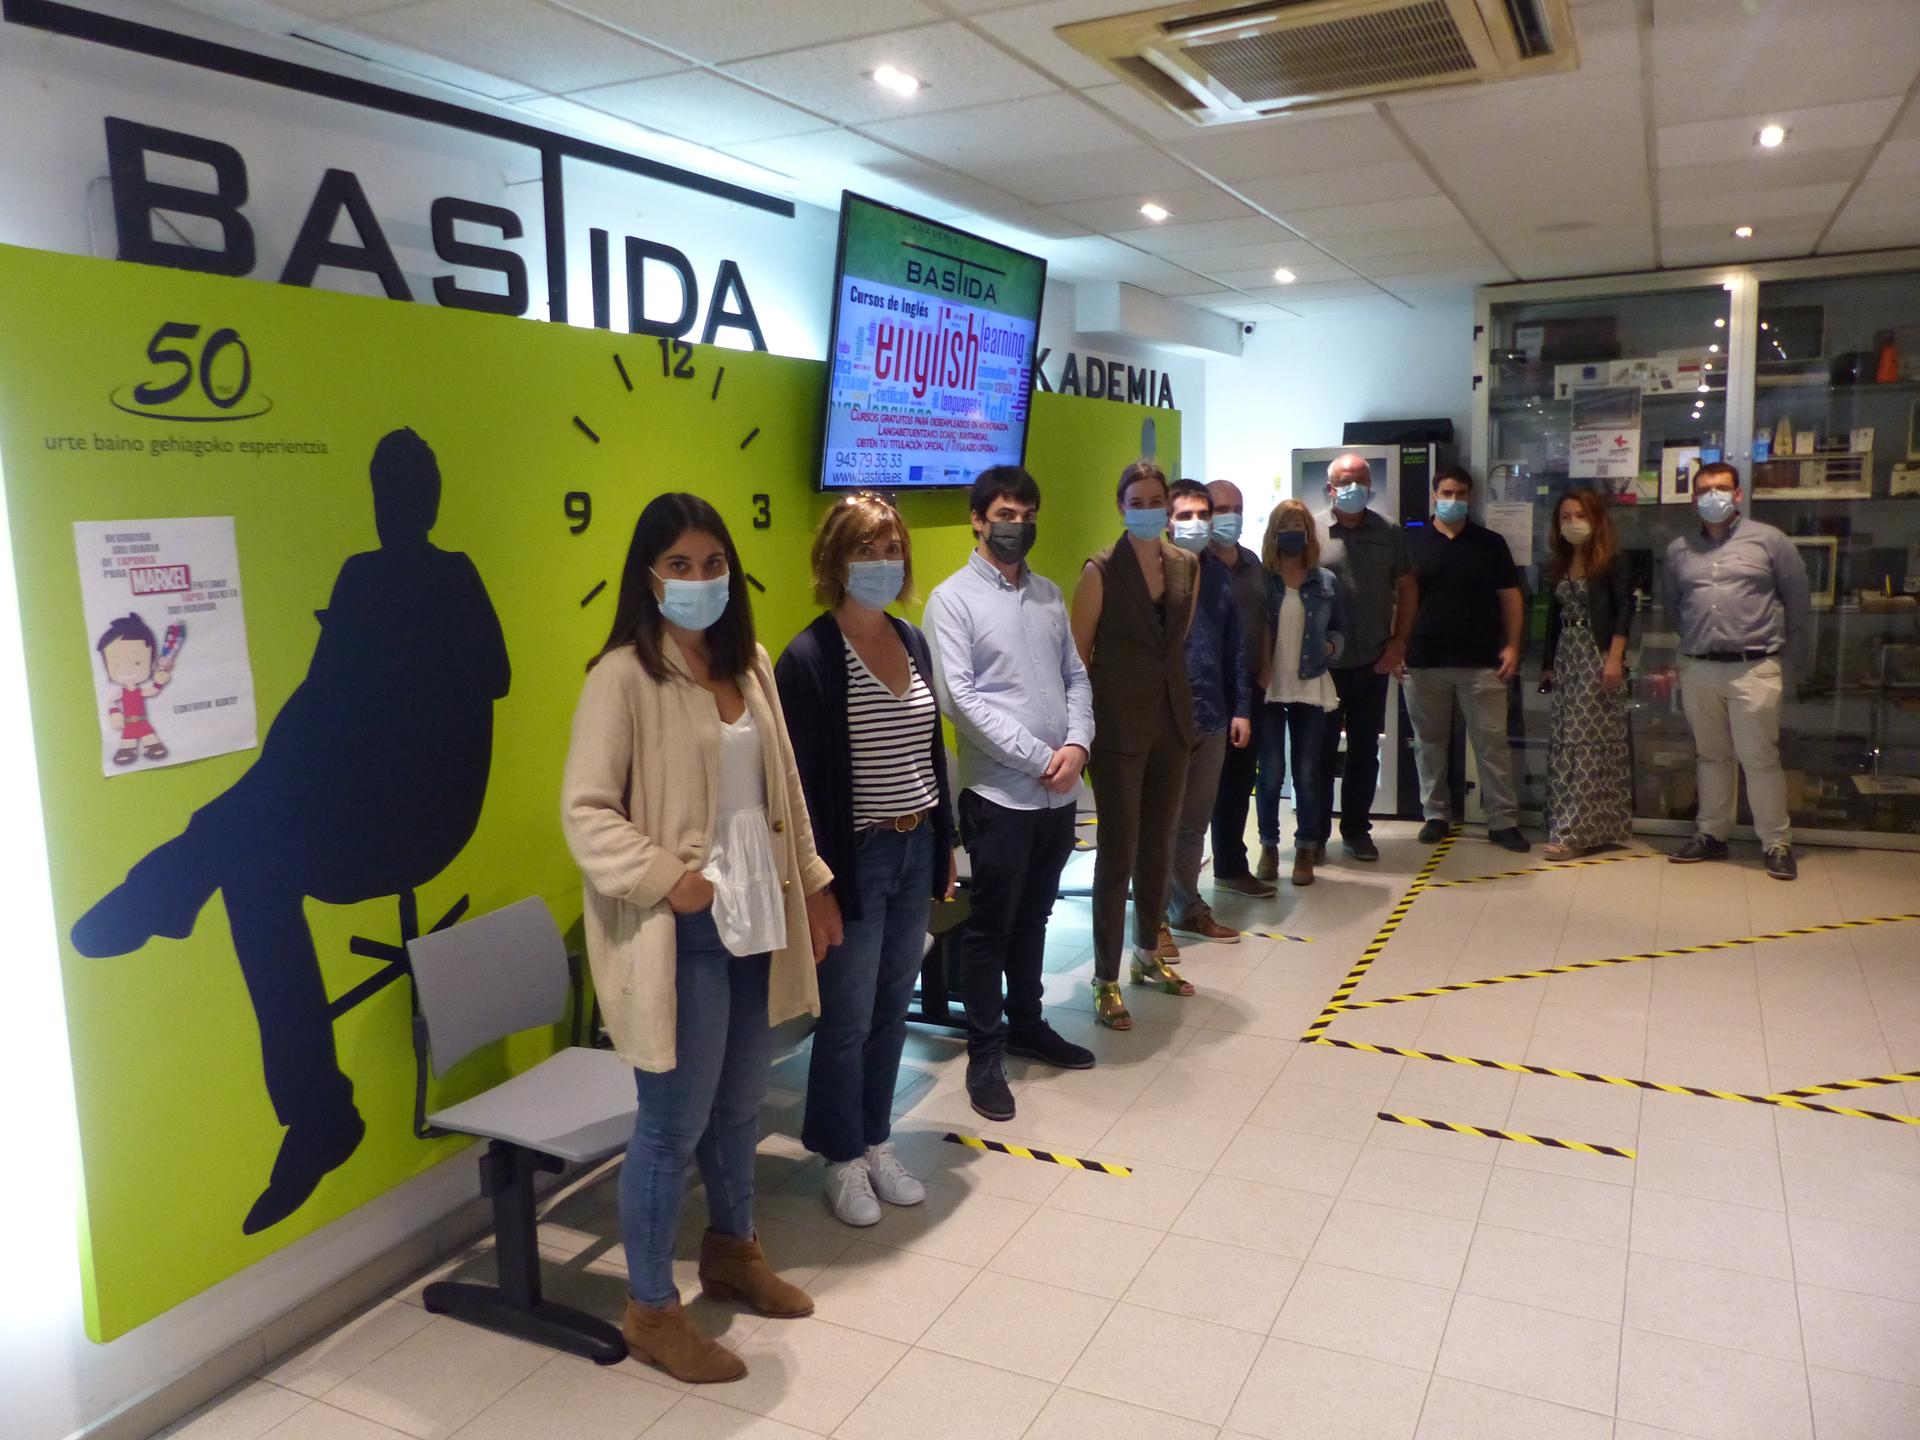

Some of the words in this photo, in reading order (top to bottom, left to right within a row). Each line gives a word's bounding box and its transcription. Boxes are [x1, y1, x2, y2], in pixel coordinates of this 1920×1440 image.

[104, 116, 768, 352] BASTIDA
[850, 285, 885, 308] Cursos
[887, 294, 899, 312] de
[901, 297, 929, 318] Inglés
[907, 260, 998, 305] BASTIDA
[658, 338, 696, 379] 12
[875, 304, 979, 399] english
[979, 315, 1026, 365] learning
[133, 321, 252, 410] 50
[942, 389, 978, 415] languages
[45, 435, 86, 451] urte
[94, 432, 144, 452] baino
[151, 434, 233, 458] gehiagoko
[240, 439, 329, 458] esperientzia
[836, 452, 857, 468] 943
[860, 452, 872, 468] 79
[889, 453, 903, 469] 33
[832, 469, 902, 484] www.bastida.es
[564, 491, 592, 534] 9
[752, 493, 772, 529] 3
[131, 566, 190, 593] MARKEL
